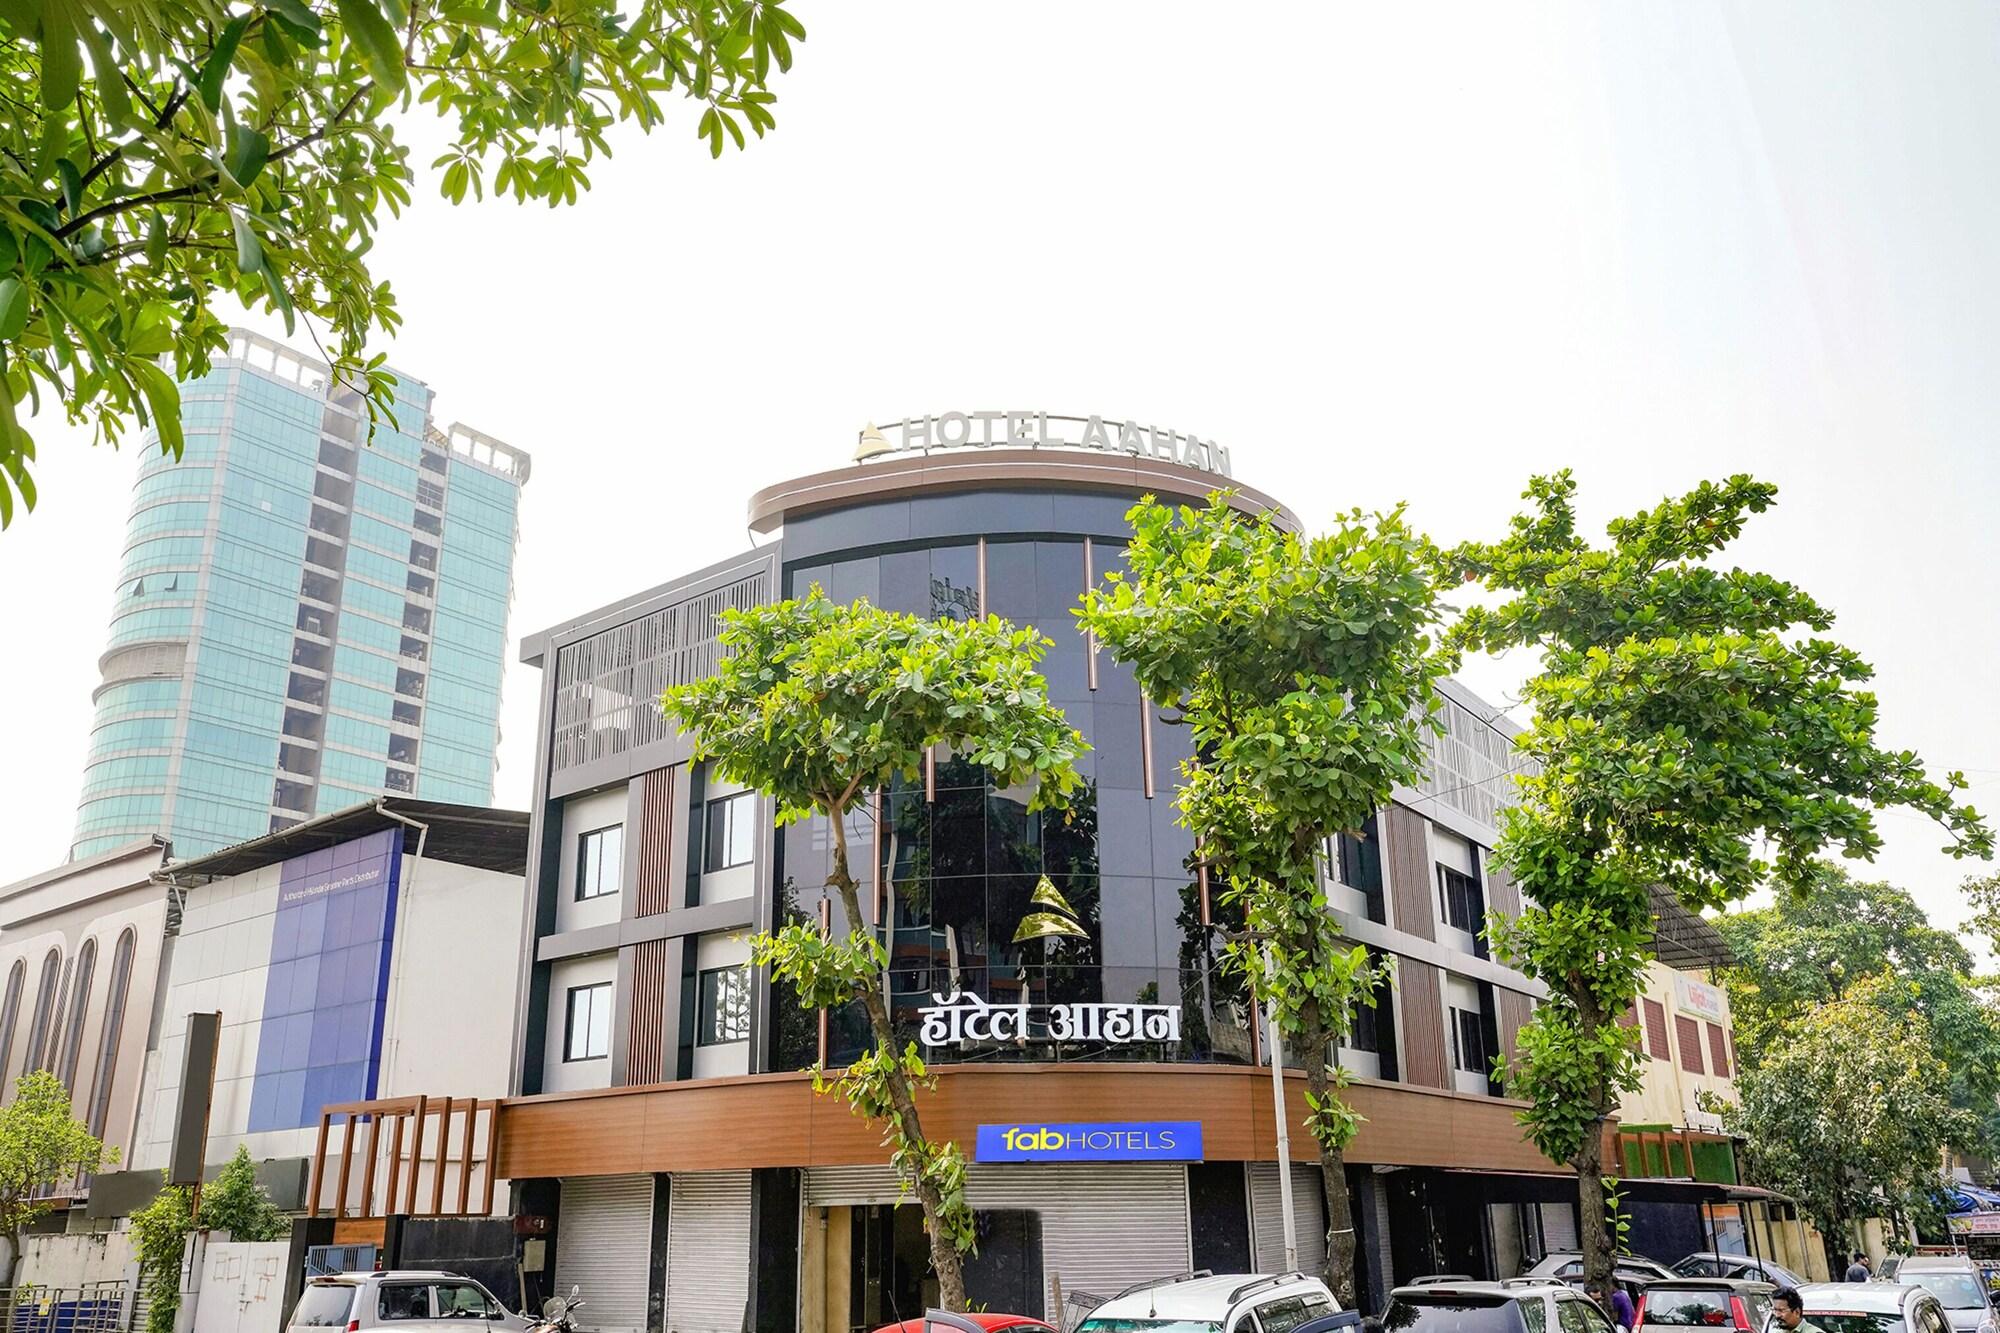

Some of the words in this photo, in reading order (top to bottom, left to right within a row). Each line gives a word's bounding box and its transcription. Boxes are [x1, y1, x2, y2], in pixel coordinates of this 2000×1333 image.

[902, 411, 1064, 451] HOTEL
[1080, 415, 1232, 478] AAHAN
[918, 992, 1031, 1046] हॉटेल
[1048, 1003, 1181, 1043] आहान
